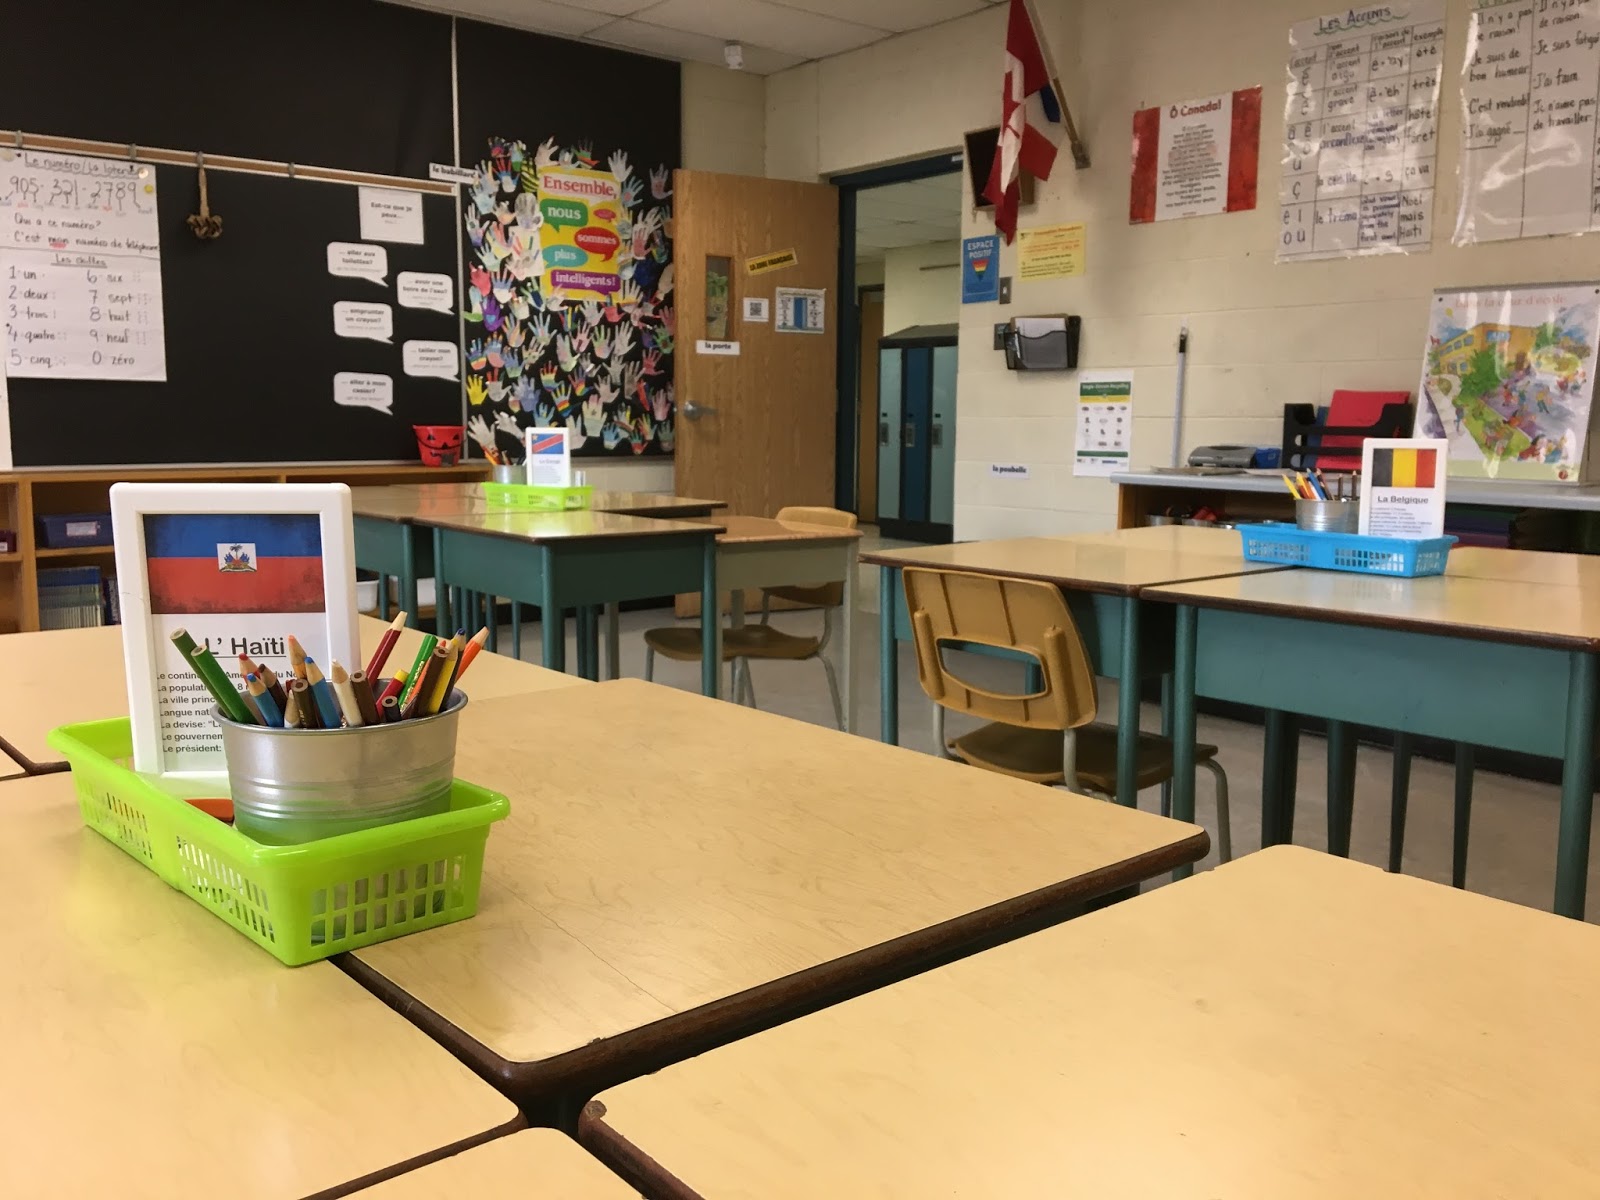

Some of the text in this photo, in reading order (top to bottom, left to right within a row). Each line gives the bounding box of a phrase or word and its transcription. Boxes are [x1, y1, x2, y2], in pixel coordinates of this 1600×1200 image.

[1169, 98, 1222, 119] Ô Canada!
[543, 175, 618, 200] Ensemble,
[547, 206, 582, 220] nous
[14, 230, 41, 243] C'est
[110, 239, 123, 249] de
[577, 233, 618, 245] sommes
[967, 239, 994, 251] ESPACE
[554, 249, 577, 262] plus
[969, 249, 992, 259] POSITIF
[9, 266, 37, 280] 1 un
[87, 270, 123, 284] 6 six
[555, 271, 616, 287] intelligents!
[8, 285, 48, 300] 2 deux
[89, 290, 133, 305] 7 sept
[9, 304, 49, 320] 3 trois
[90, 307, 130, 322] 8 huit
[25, 329, 55, 343] quatre
[89, 328, 130, 344] 9 neuf
[713, 343, 732, 351] porte
[11, 348, 51, 368] 5 cinq
[111, 354, 135, 366] zéro
[992, 464, 1027, 474] la poubelle
[1377, 495, 1429, 505] La Belgique
[231, 637, 285, 655] Haïti
[170, 696, 189, 704] ville
[173, 721, 206, 729] devise:
[163, 744, 222, 754] Le président:
